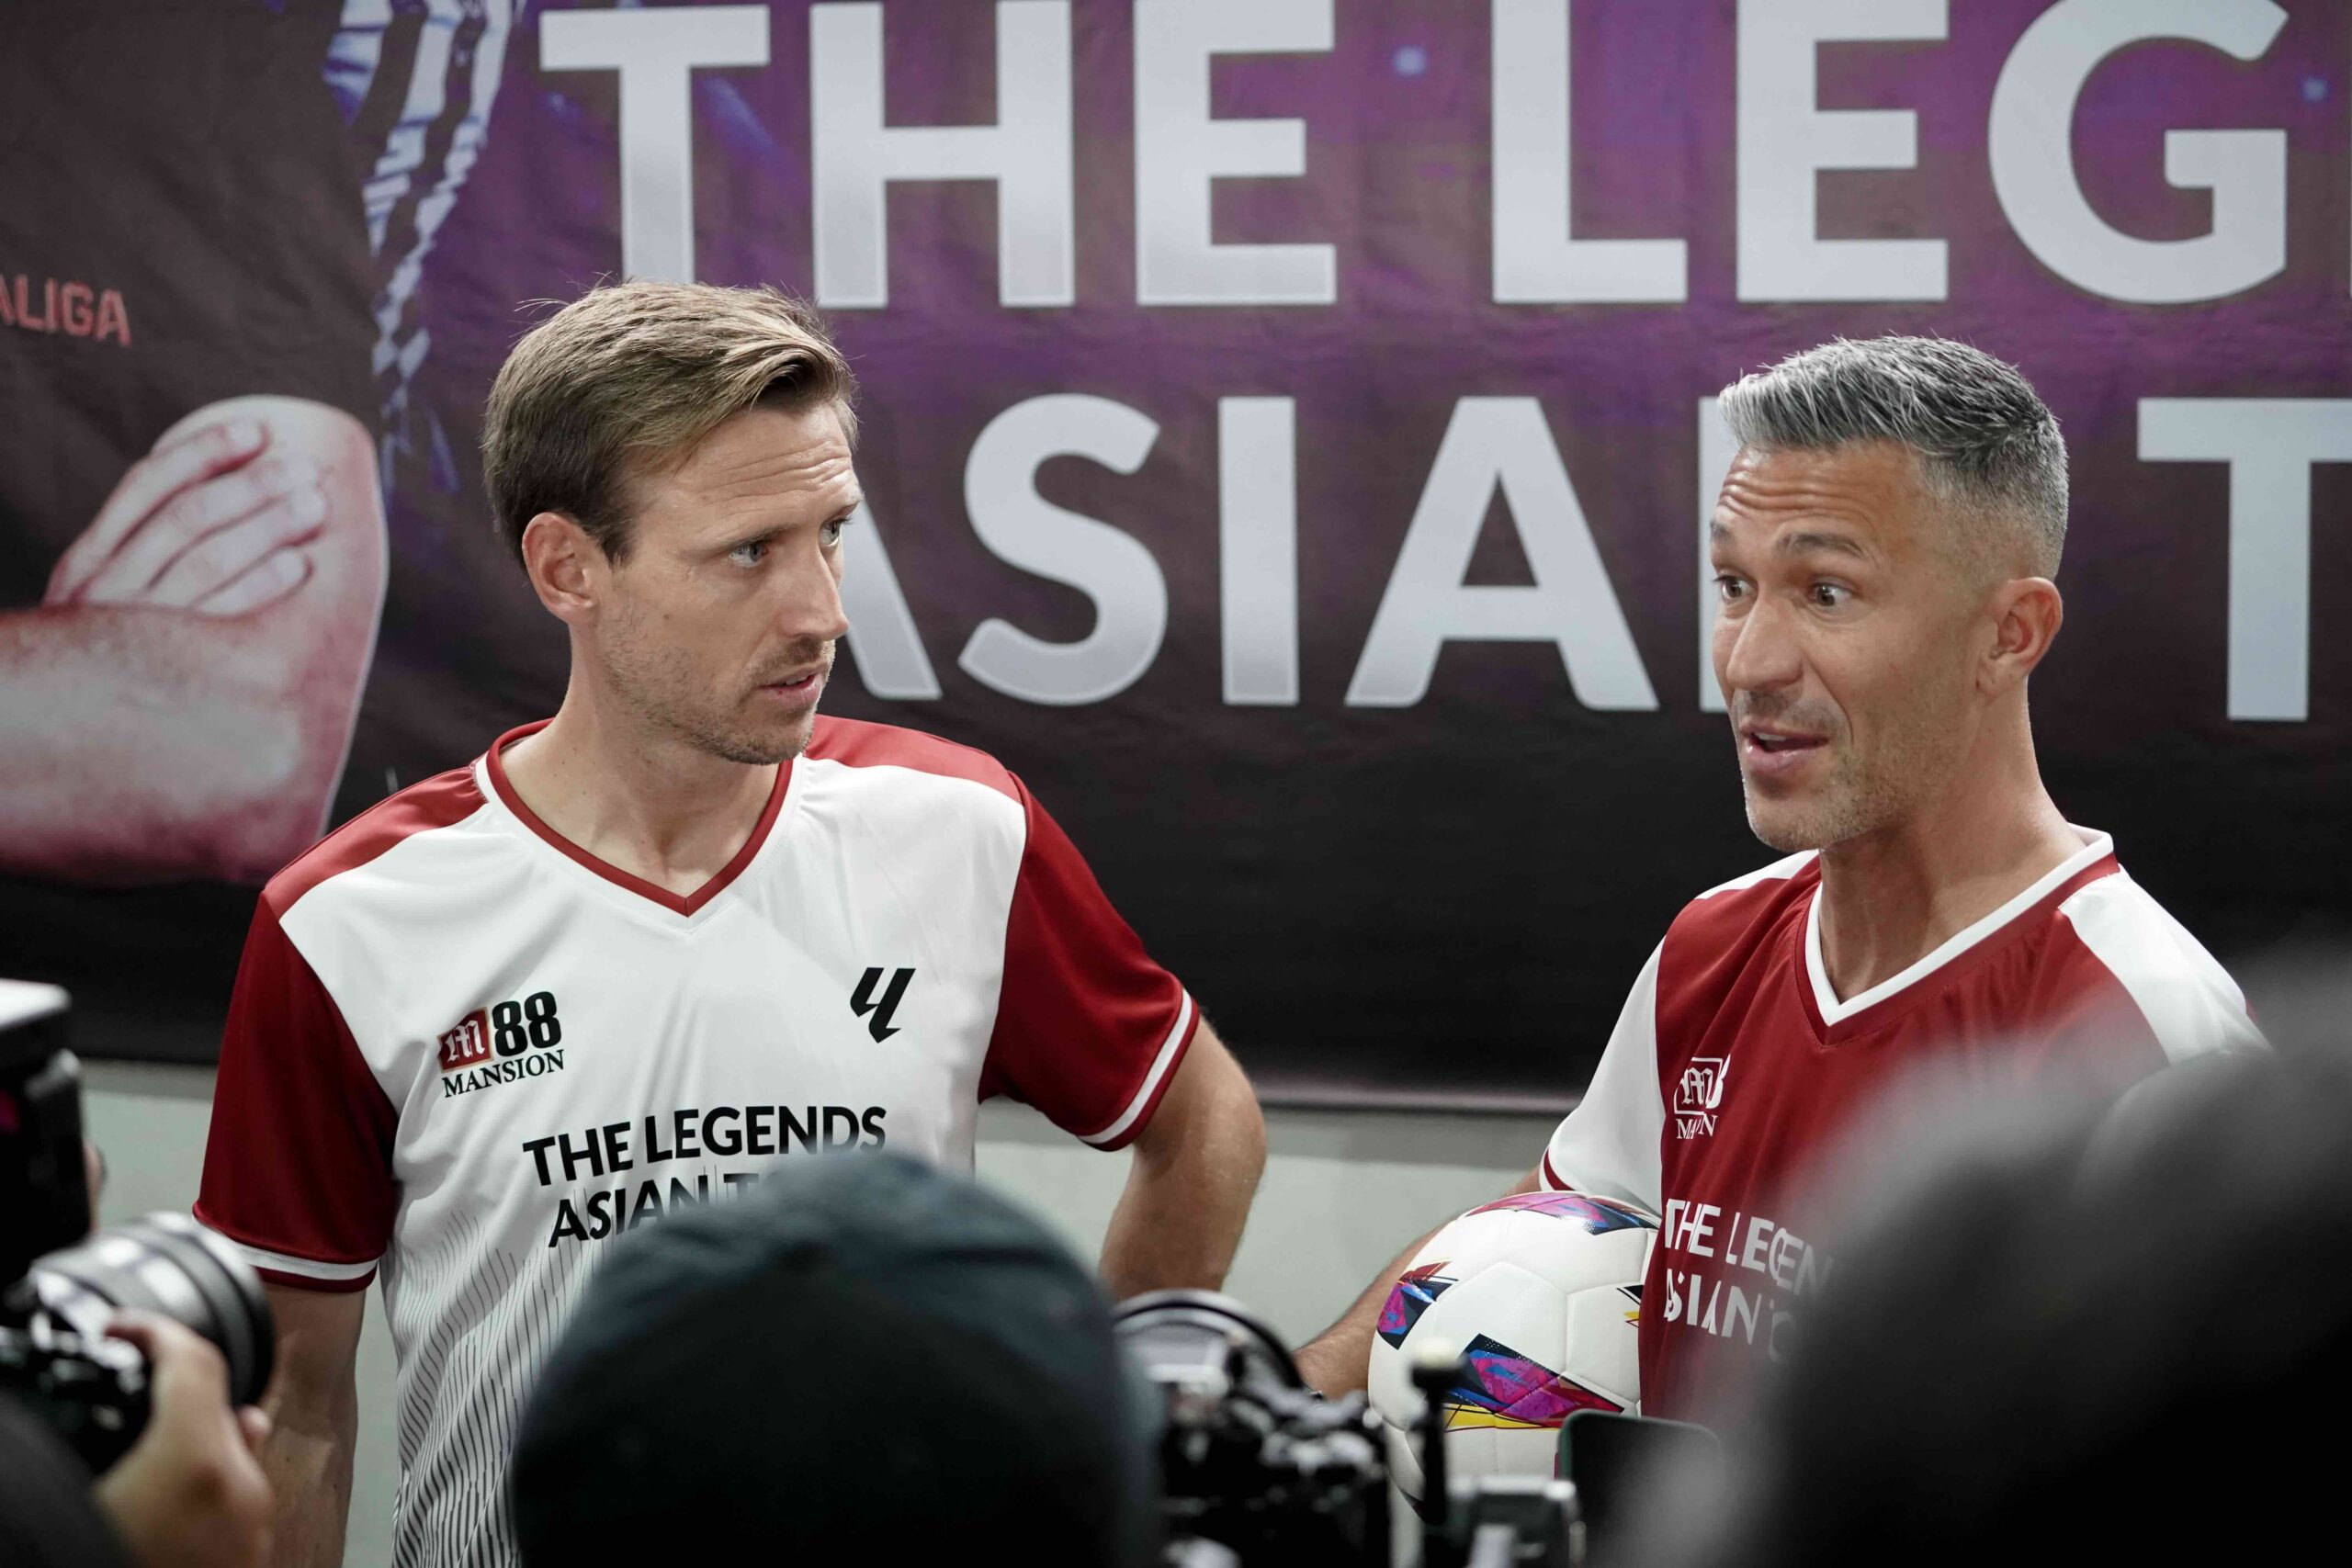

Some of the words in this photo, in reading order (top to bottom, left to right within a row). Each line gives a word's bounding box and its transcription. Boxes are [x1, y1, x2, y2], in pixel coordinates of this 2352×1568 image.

[538, 0, 1338, 309] THE
[1490, 0, 2352, 305] LEG
[840, 393, 1736, 714] SIA
[441, 1049, 565, 1099] MANSION
[522, 1121, 634, 1187] THE
[645, 1105, 887, 1164] LEGENDS
